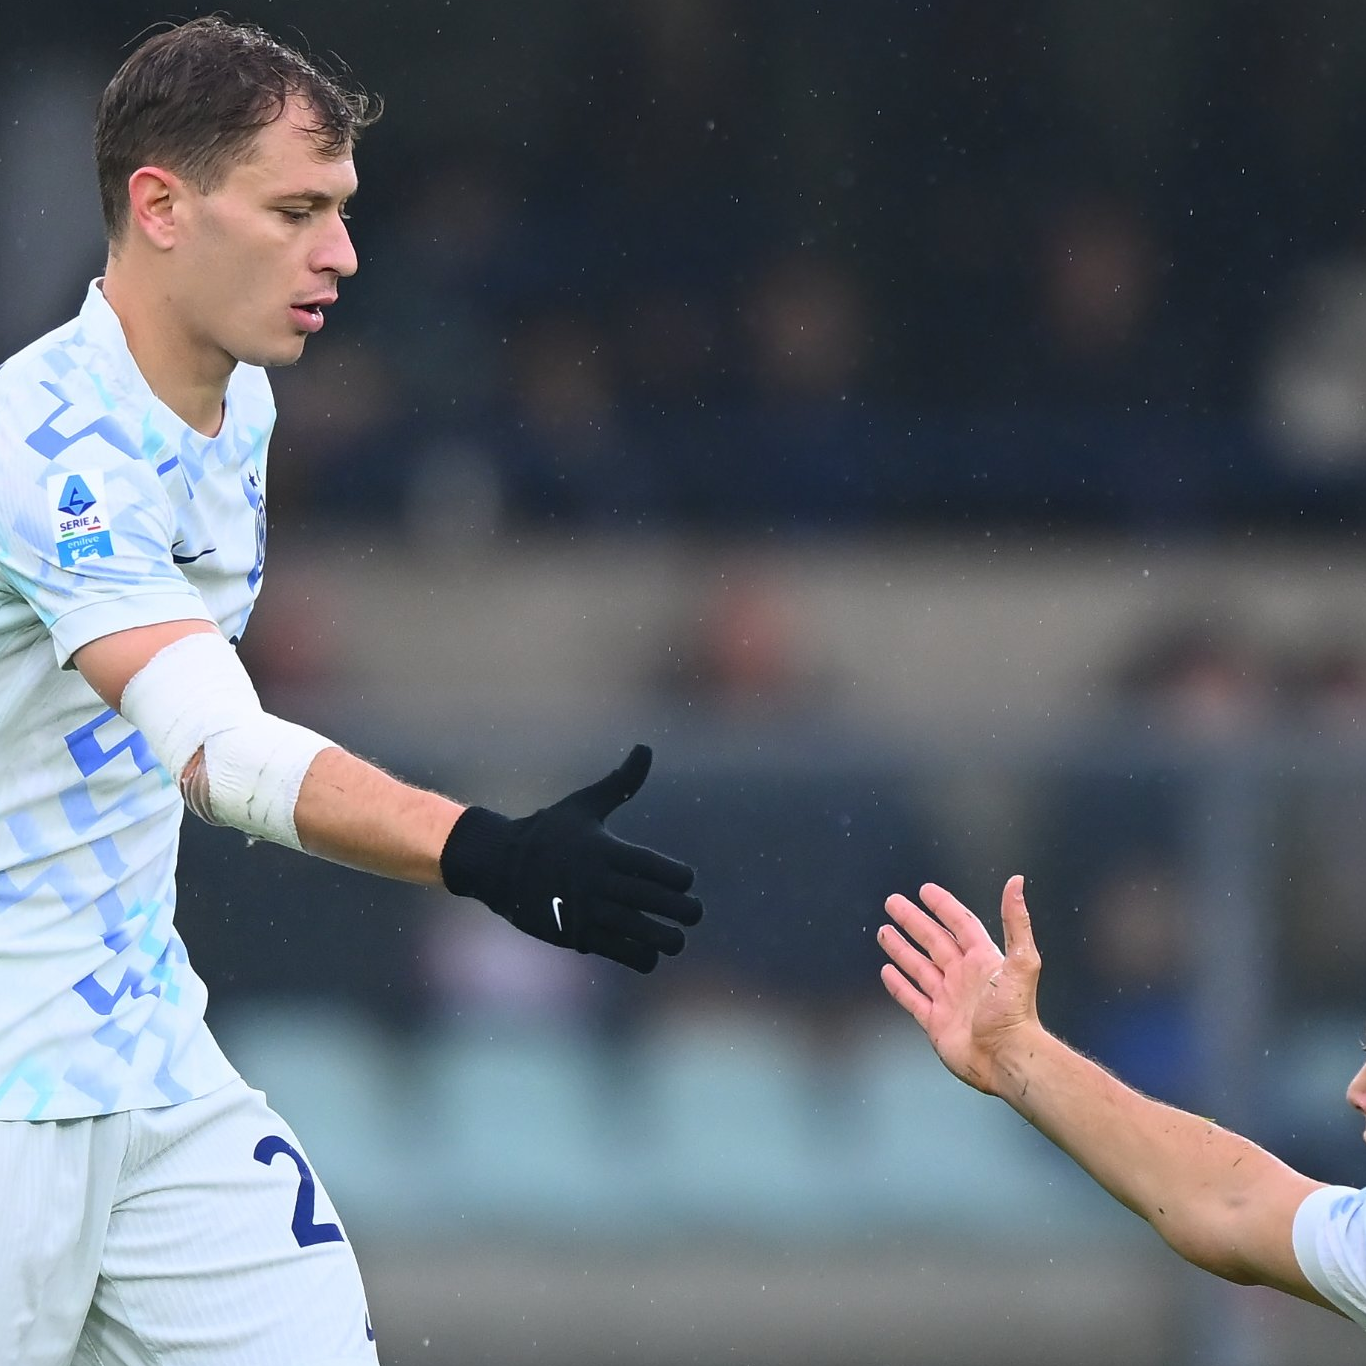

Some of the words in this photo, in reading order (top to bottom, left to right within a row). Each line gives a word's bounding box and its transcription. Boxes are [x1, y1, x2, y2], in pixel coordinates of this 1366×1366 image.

[60, 517, 90, 532] SERIE
[93, 516, 101, 524] A
[67, 536, 100, 549] enilive
[253, 1135, 344, 1248] 2
